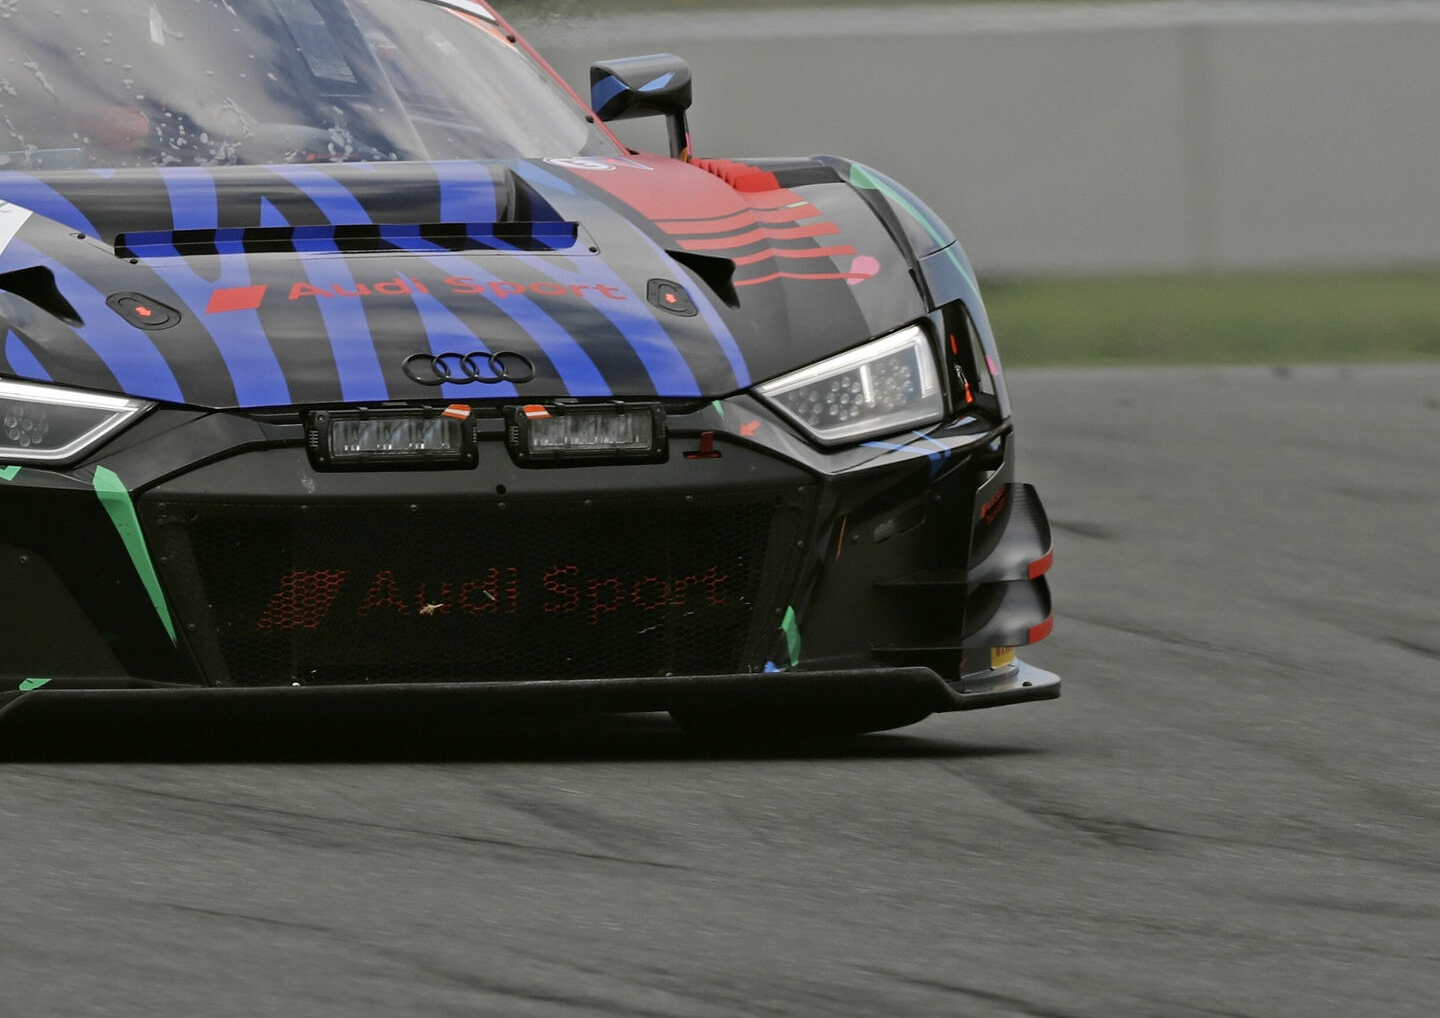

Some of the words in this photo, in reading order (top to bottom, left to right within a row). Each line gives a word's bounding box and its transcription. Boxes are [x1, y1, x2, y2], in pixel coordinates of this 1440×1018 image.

[288, 277, 431, 300] Audi
[442, 276, 627, 300] Sport
[359, 567, 518, 616] Audi
[542, 565, 729, 626] Sport
